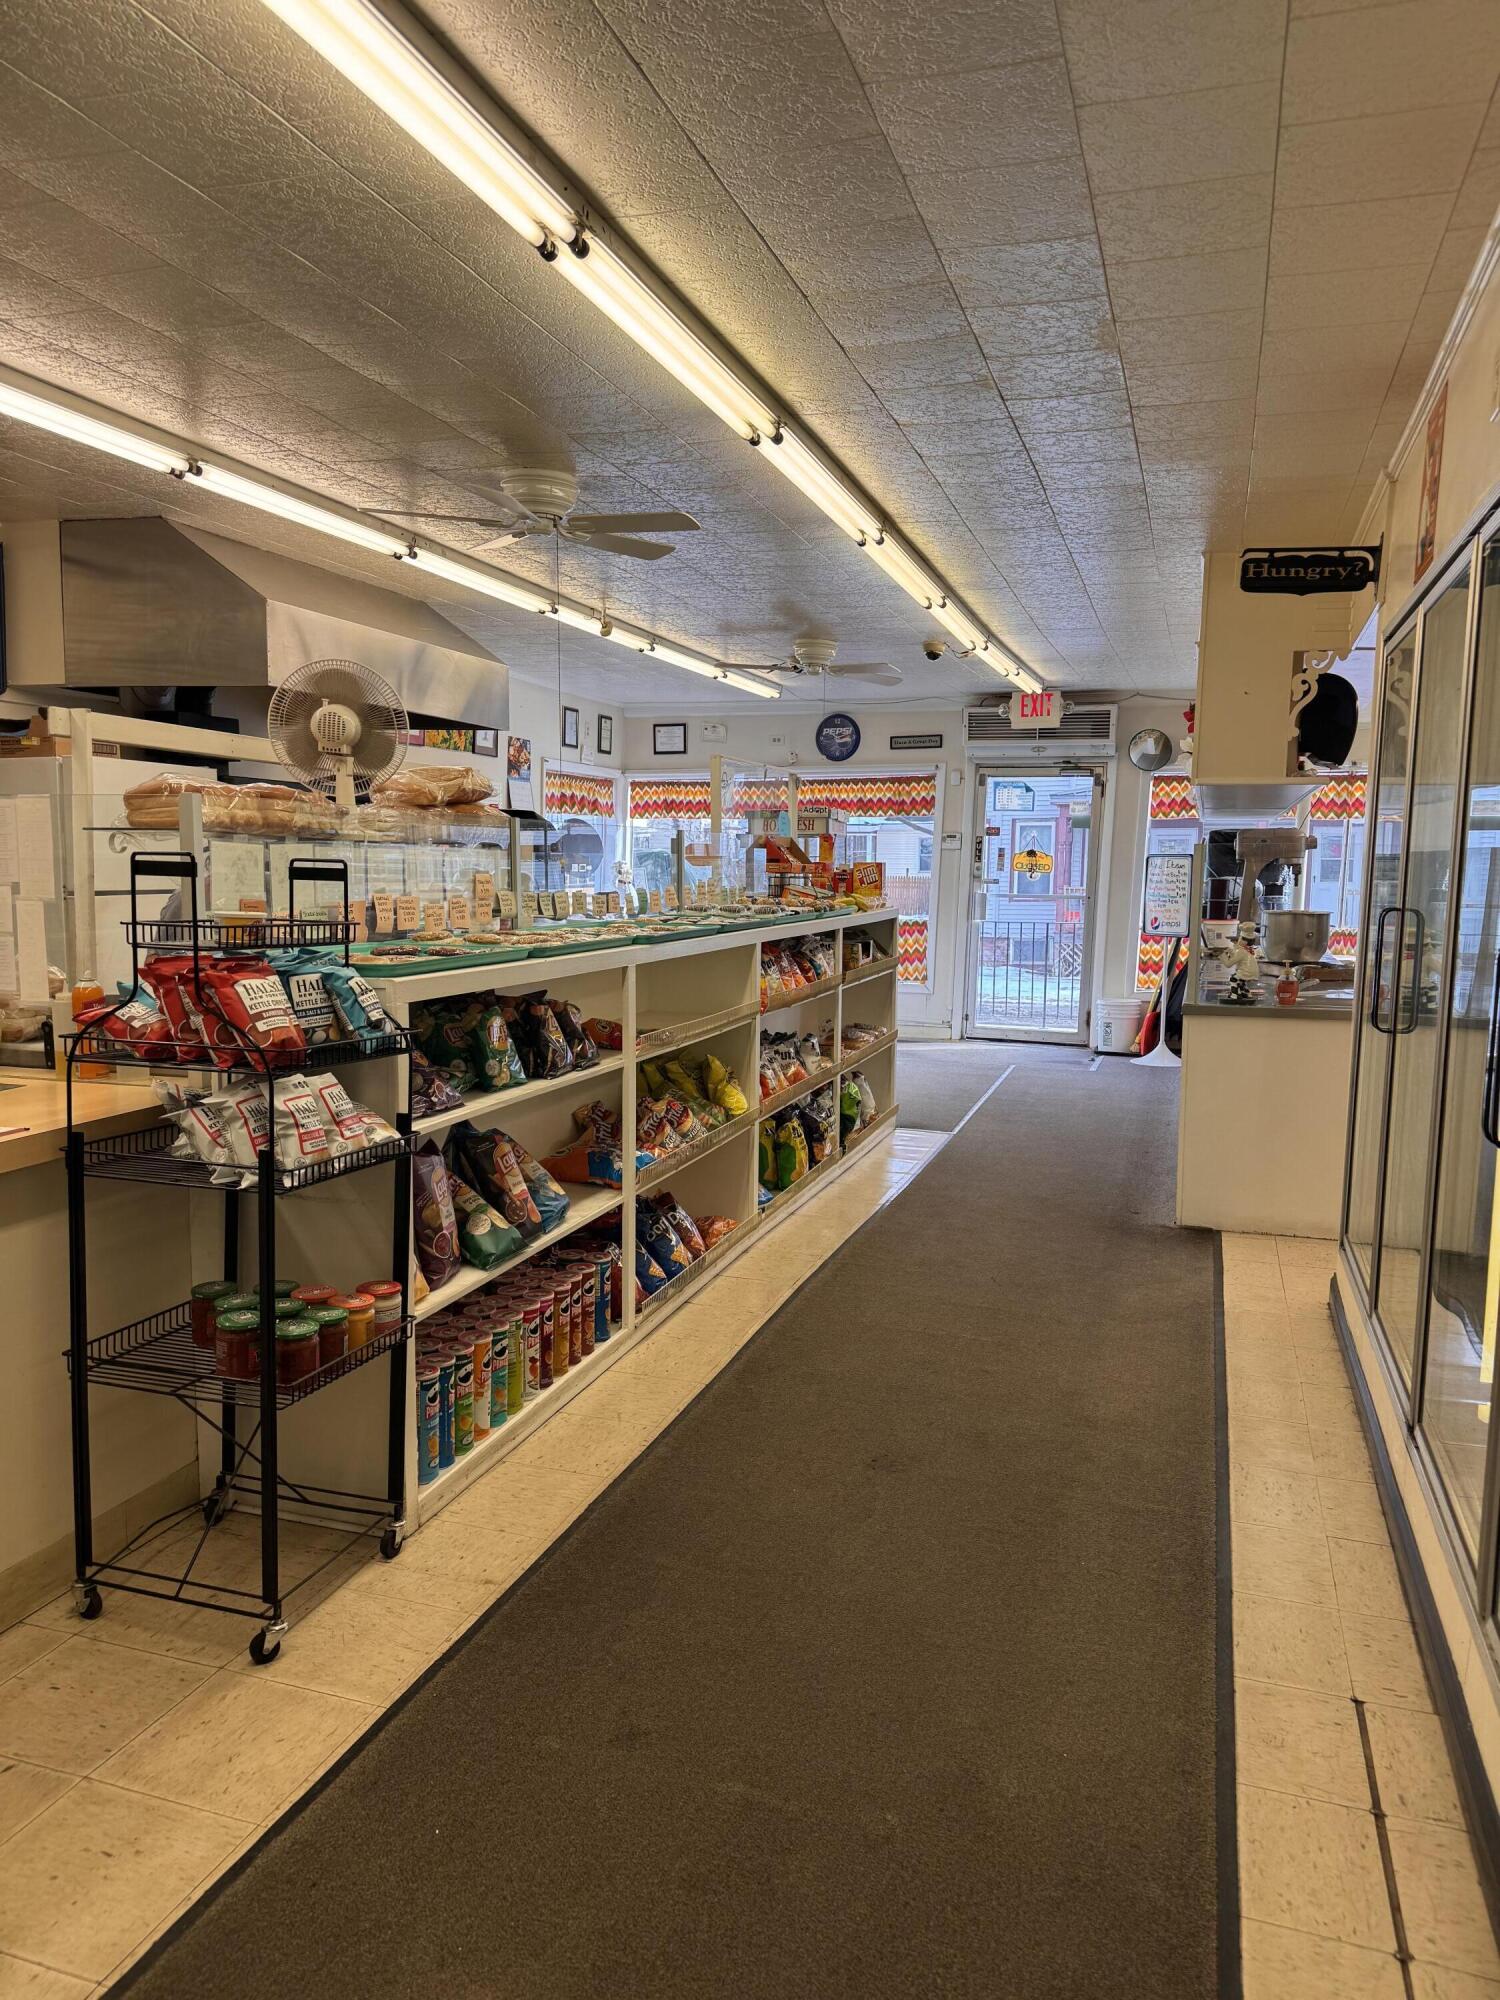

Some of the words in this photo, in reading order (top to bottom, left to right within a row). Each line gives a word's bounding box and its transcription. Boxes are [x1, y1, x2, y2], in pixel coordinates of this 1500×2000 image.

[1246, 561, 1364, 580] Hungry?
[1021, 693, 1054, 718] EXIT
[823, 727, 852, 735] PEPSI
[797, 818, 815, 831] ESH
[1015, 861, 1051, 871] CLOSED
[296, 979, 325, 993] HAL
[248, 1000, 272, 1011] KETTLE
[296, 998, 319, 1008] KETTLE
